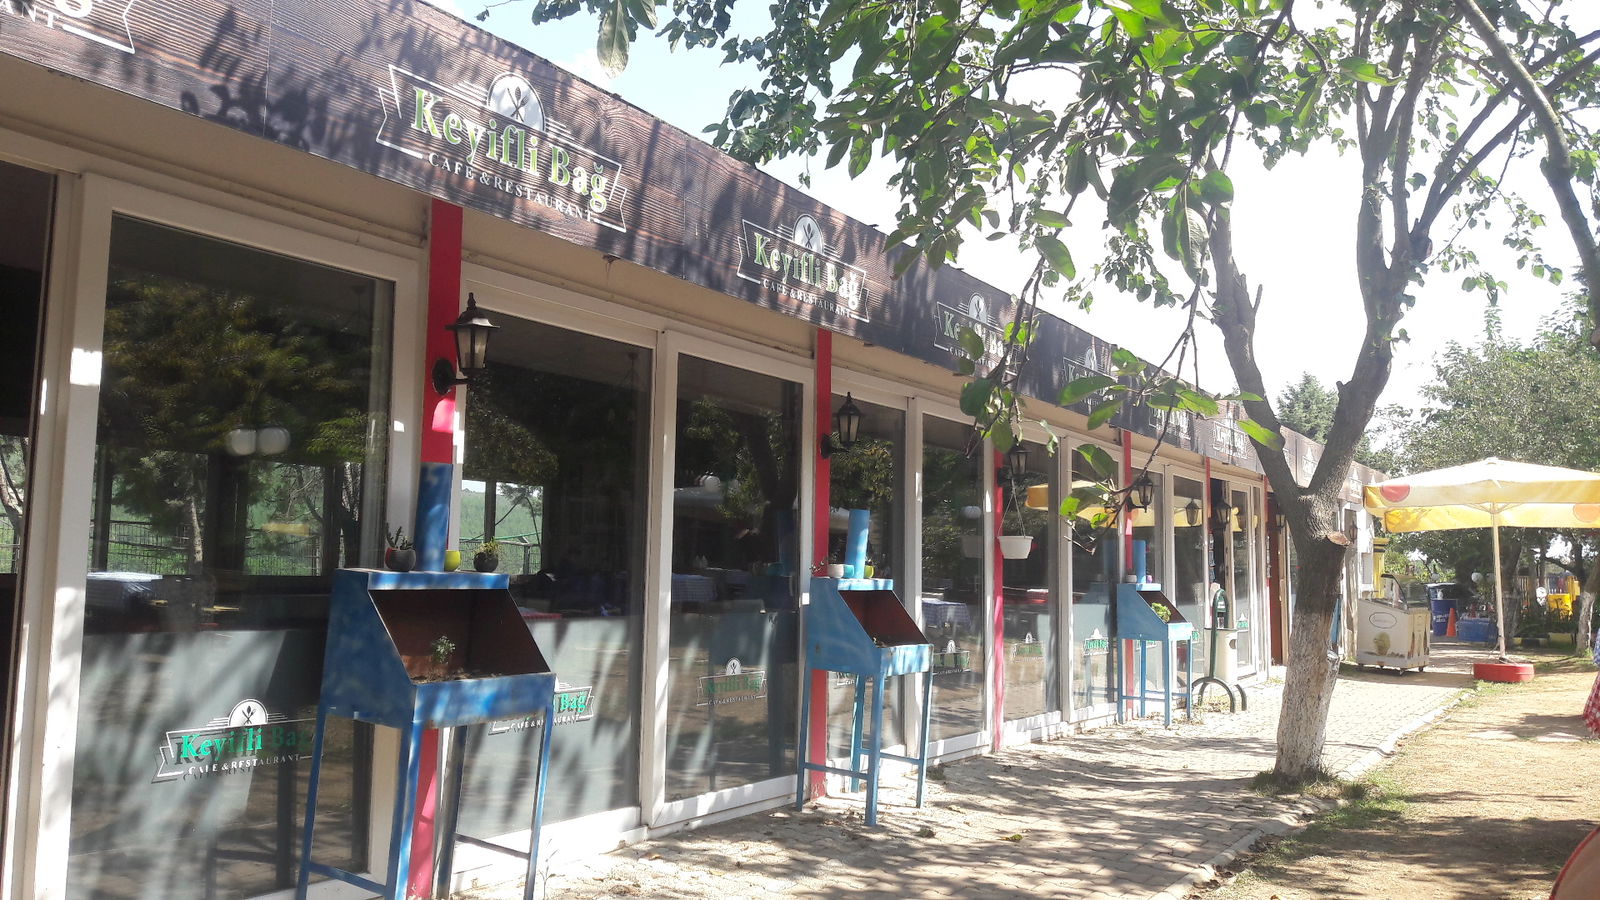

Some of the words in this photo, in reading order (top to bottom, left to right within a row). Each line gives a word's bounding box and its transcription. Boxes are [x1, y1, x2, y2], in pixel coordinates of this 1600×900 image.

[411, 86, 540, 176] Keyifli
[548, 146, 608, 213] Bağ
[428, 153, 474, 180] CAFE
[494, 176, 595, 223] RESTAURANT
[753, 232, 822, 289] Keyifli
[560, 691, 587, 713] Bağ
[179, 727, 263, 761] Keyifli
